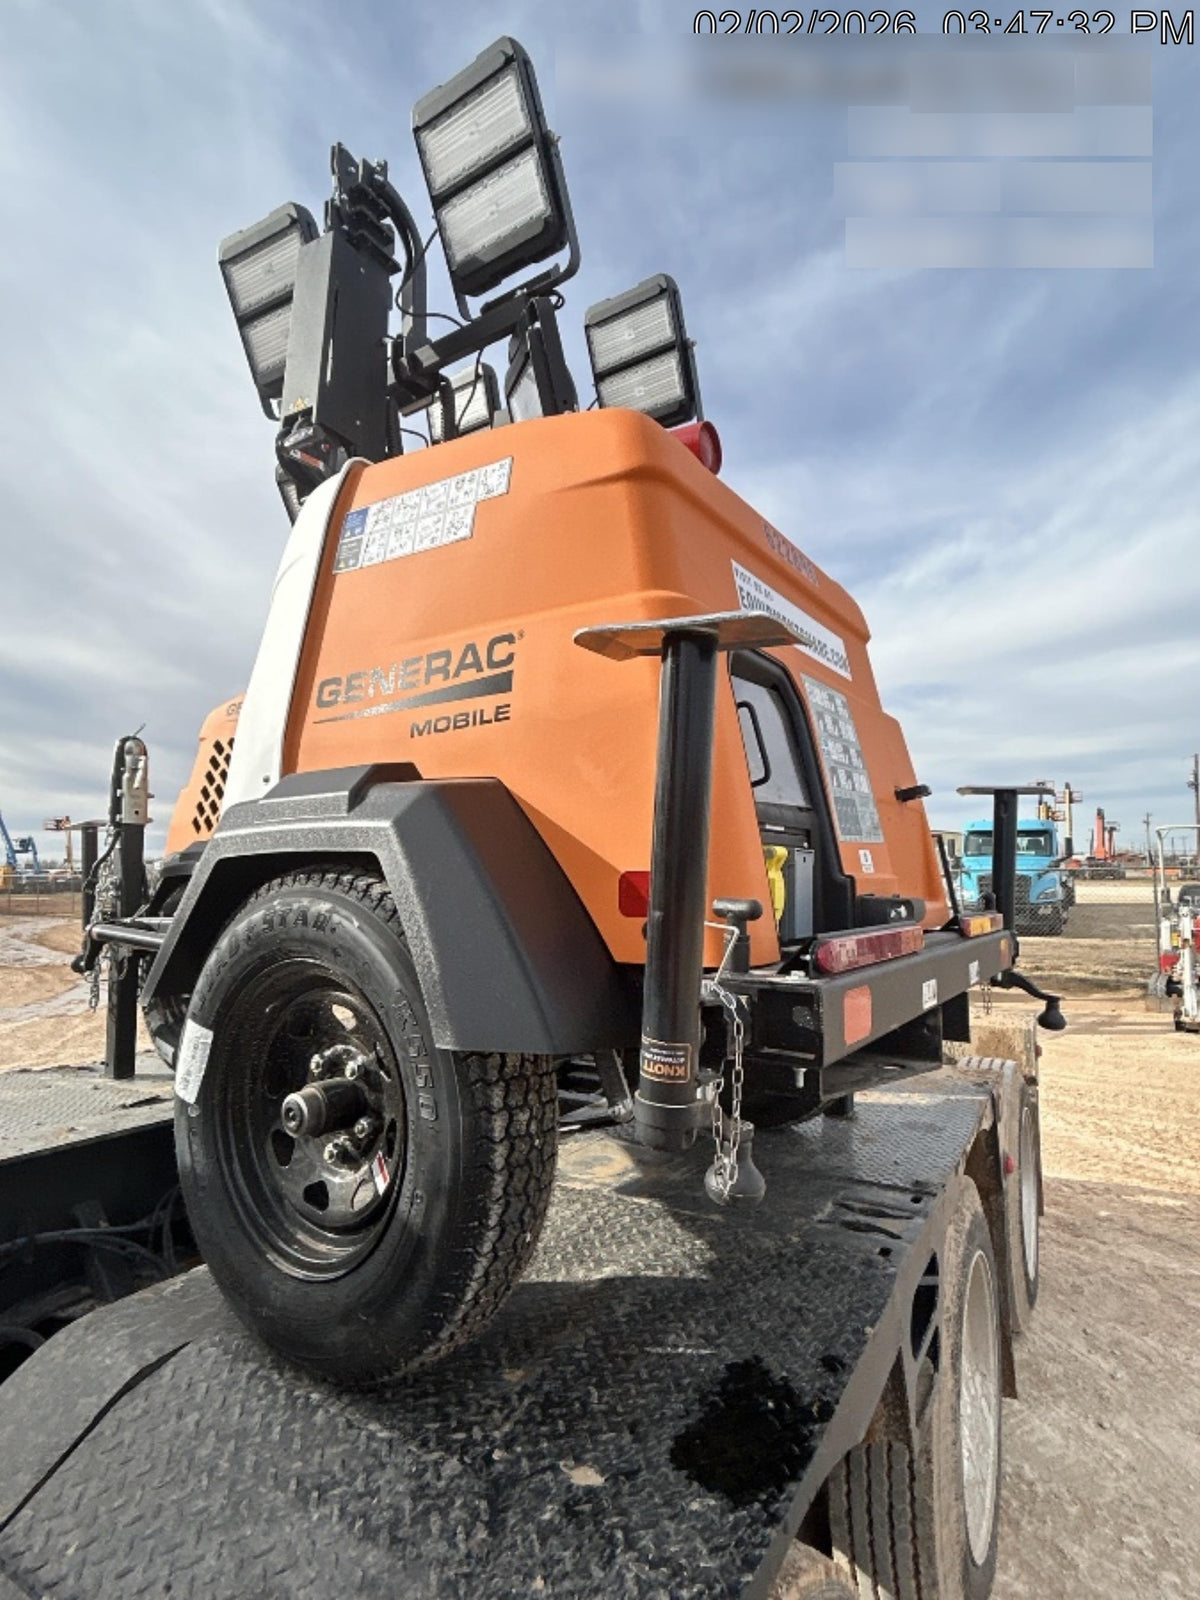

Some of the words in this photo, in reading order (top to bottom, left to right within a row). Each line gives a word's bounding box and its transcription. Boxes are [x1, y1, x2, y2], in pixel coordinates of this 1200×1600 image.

[316, 632, 516, 708] GENERAC
[410, 703, 511, 738] MOBILE
[643, 1059, 686, 1077] KNOTT
